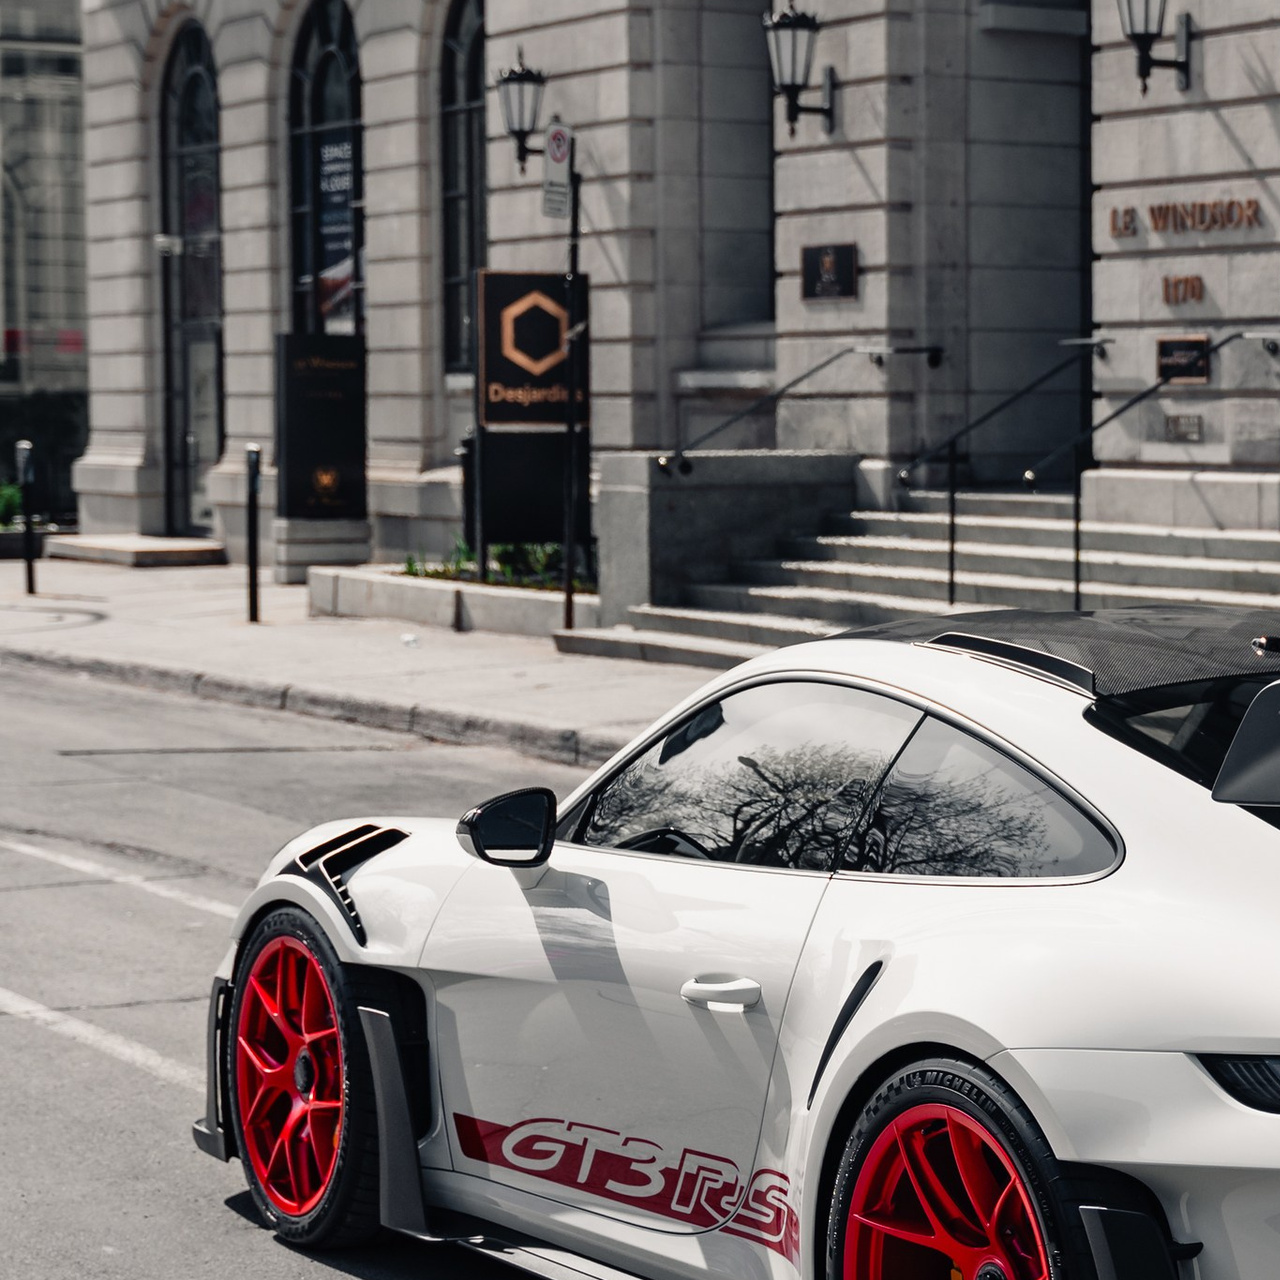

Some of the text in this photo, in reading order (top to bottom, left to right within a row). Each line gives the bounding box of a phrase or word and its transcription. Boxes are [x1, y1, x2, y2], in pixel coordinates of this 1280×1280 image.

[1110, 199, 1264, 238] LE WINDSOR
[923, 1070, 996, 1114] MICHELIN
